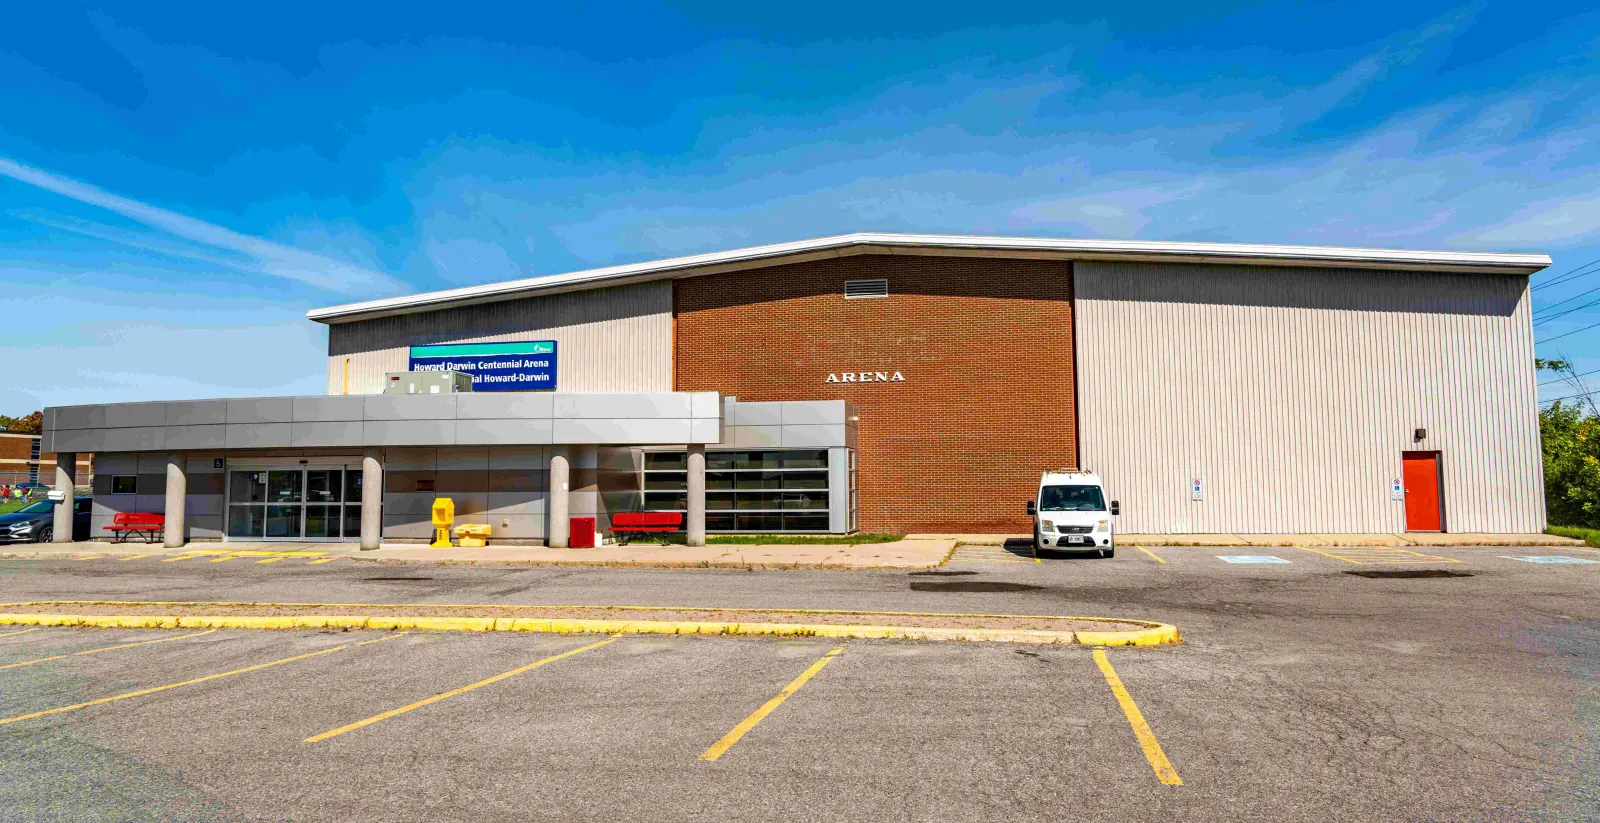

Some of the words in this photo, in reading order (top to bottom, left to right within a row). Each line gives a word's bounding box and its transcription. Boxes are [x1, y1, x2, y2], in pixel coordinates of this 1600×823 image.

[414, 361, 445, 372] Howard
[447, 361, 476, 371] Darwin
[478, 359, 522, 370] Centennial
[523, 359, 549, 368] Arena
[484, 372, 550, 383] Howard-Darwin
[825, 371, 906, 383] ARENA
